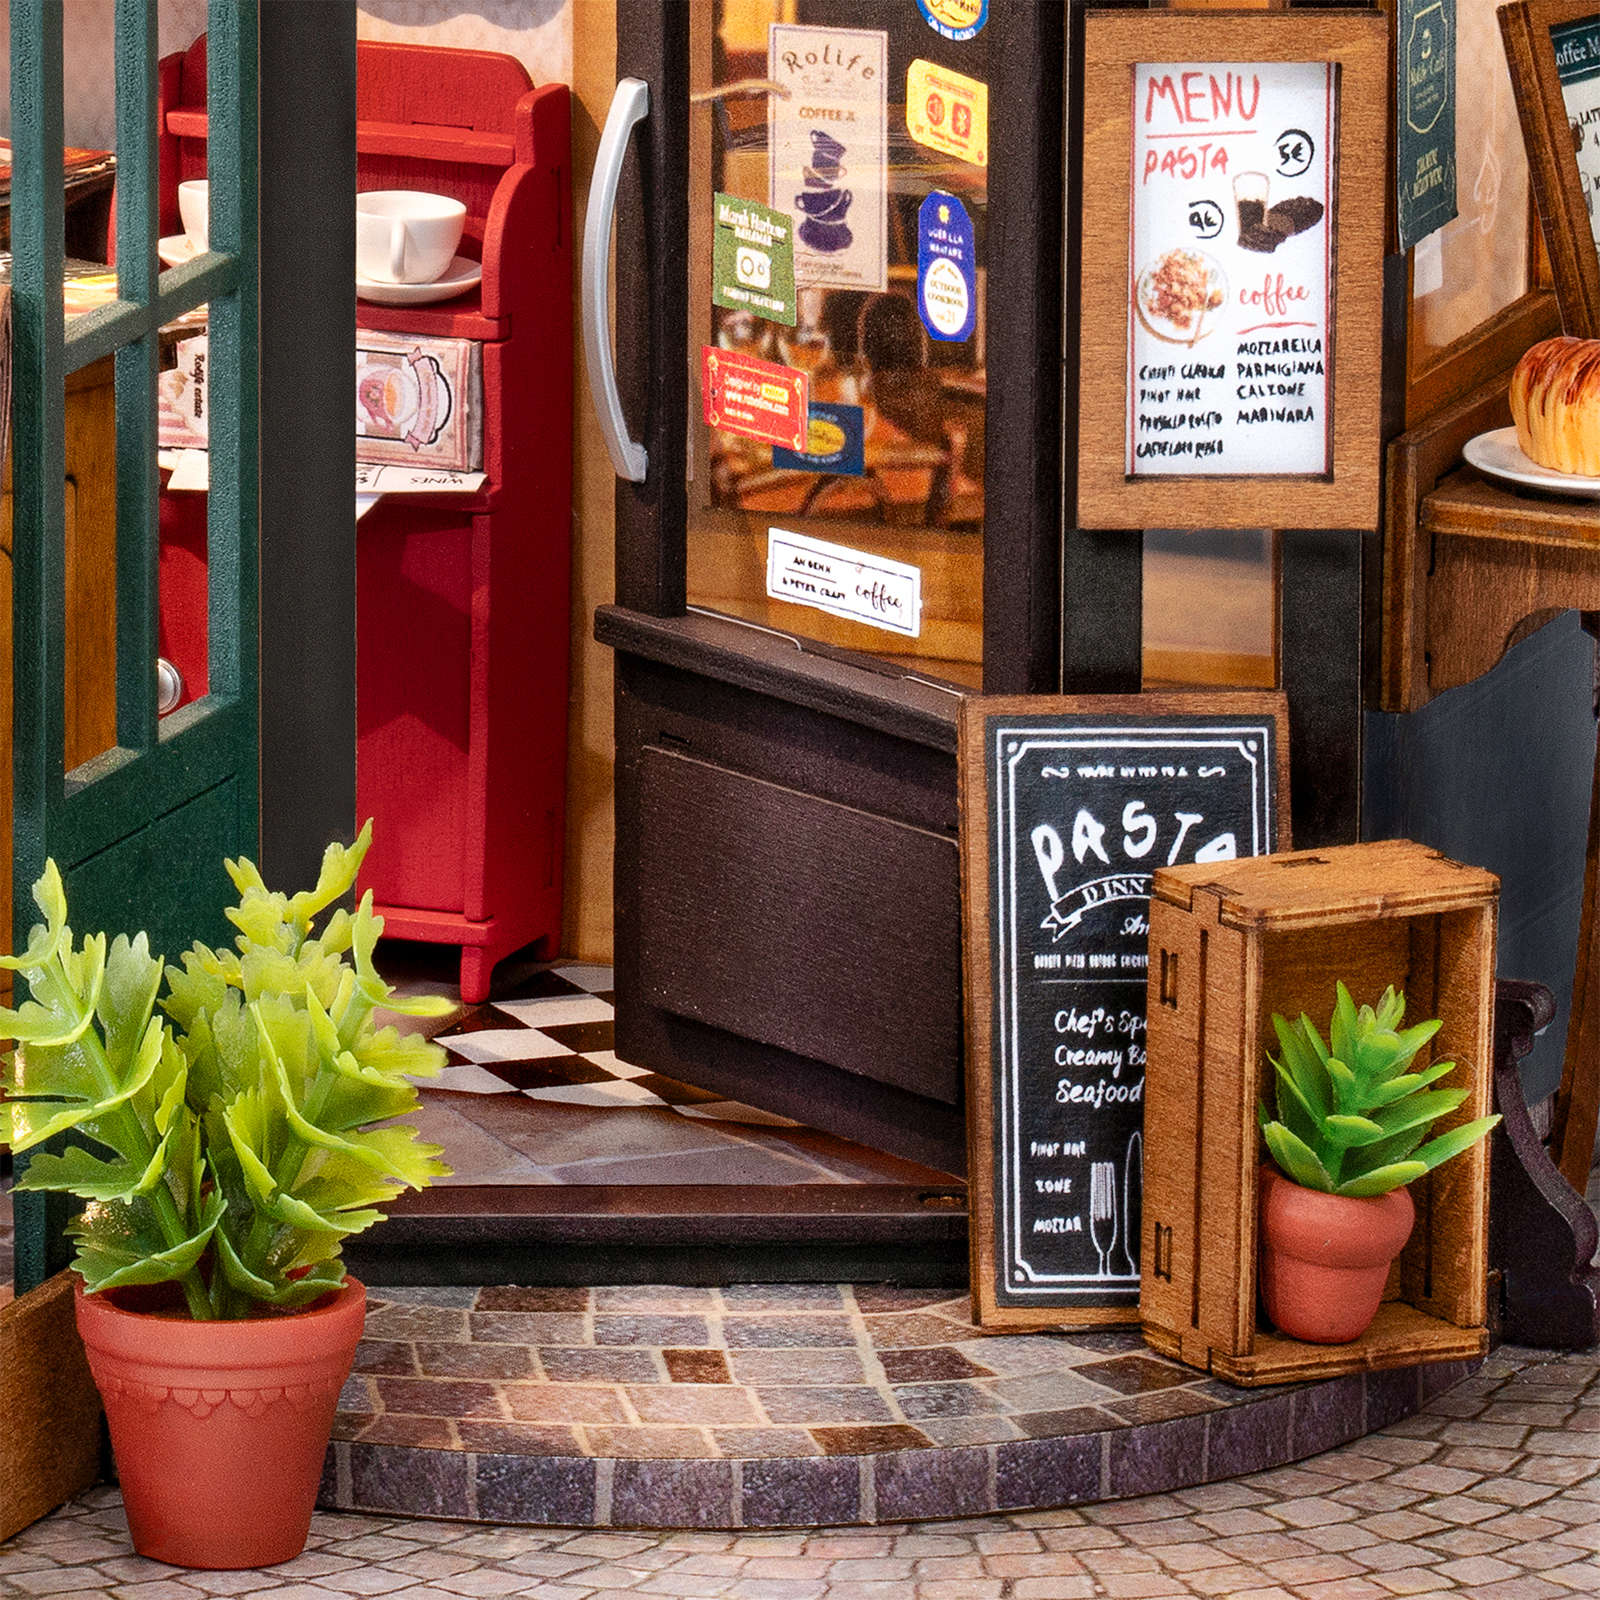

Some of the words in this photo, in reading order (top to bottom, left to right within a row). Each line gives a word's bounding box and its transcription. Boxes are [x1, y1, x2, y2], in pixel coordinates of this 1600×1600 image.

[782, 44, 875, 80] Rolife
[1555, 42, 1587, 67] offee
[1145, 71, 1260, 124] MENU
[1143, 143, 1229, 185] PASTA
[1278, 142, 1305, 166] 5€
[1239, 273, 1310, 316] coffee
[1237, 338, 1322, 356] MOZZARELLA
[1236, 360, 1325, 379] PARMIGIANA
[1236, 382, 1306, 400] CALZONE
[1236, 406, 1315, 425] MARINARA
[855, 580, 902, 613] coffee
[1031, 800, 1237, 900] PASTA
[1054, 1007, 1114, 1039] Chef's
[1054, 1044, 1122, 1078] Creamy
[1055, 1076, 1144, 1109] Seafood
[1035, 1178, 1072, 1194] ZONE
[1033, 1215, 1082, 1234] MOZZAR
